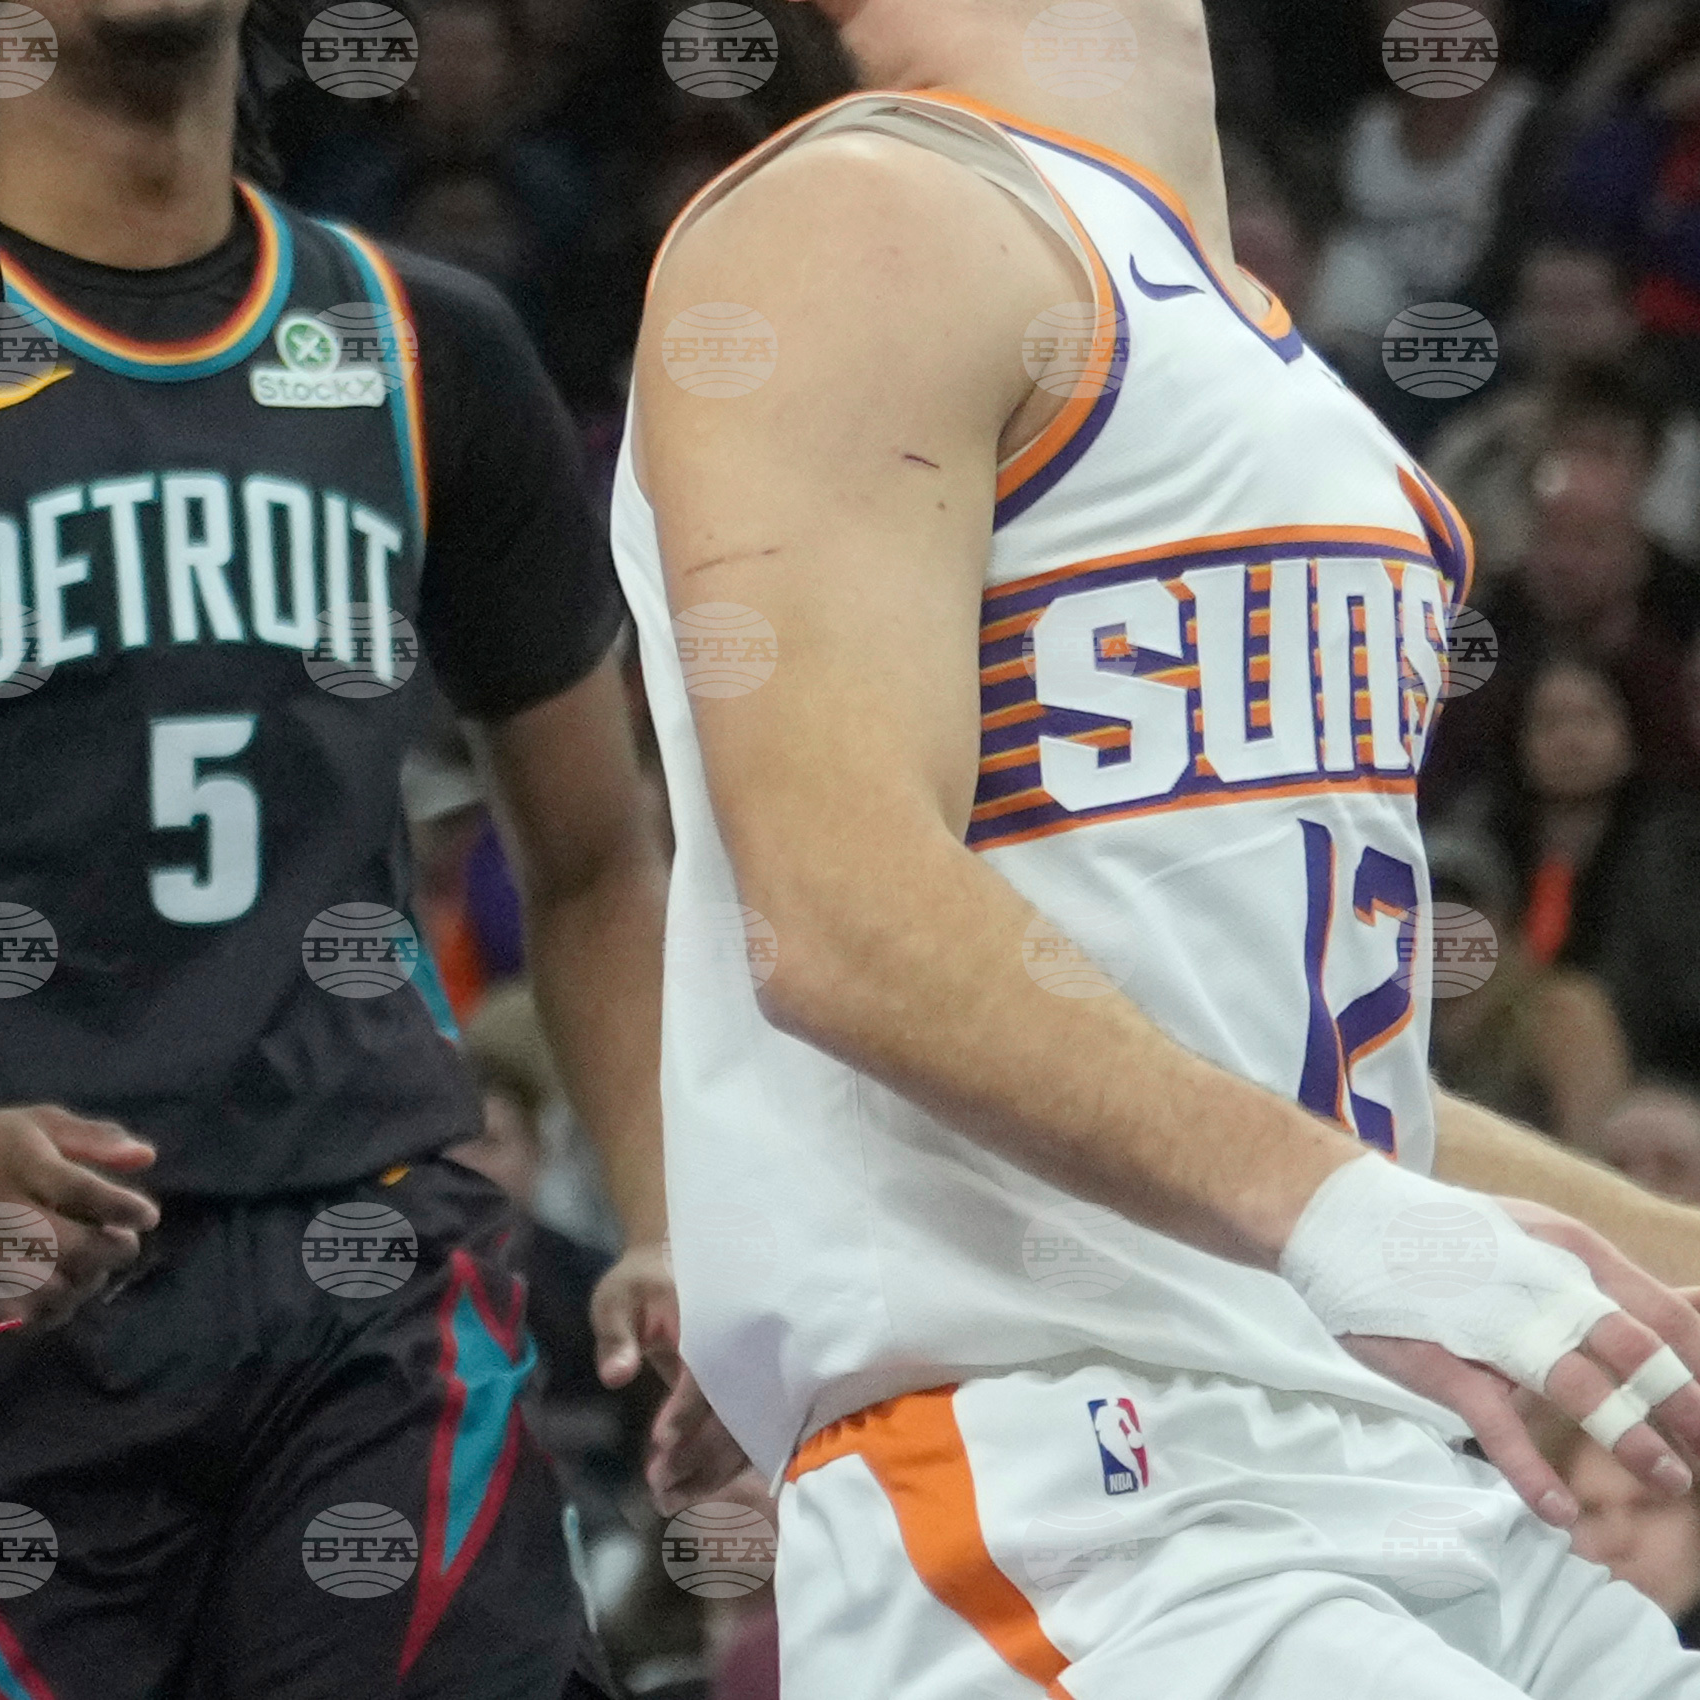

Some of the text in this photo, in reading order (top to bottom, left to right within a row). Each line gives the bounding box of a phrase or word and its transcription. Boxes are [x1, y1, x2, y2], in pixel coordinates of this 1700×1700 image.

[1036, 557, 1451, 813] SUNS
[148, 714, 261, 925] 5
[1294, 819, 1432, 1160] 12
